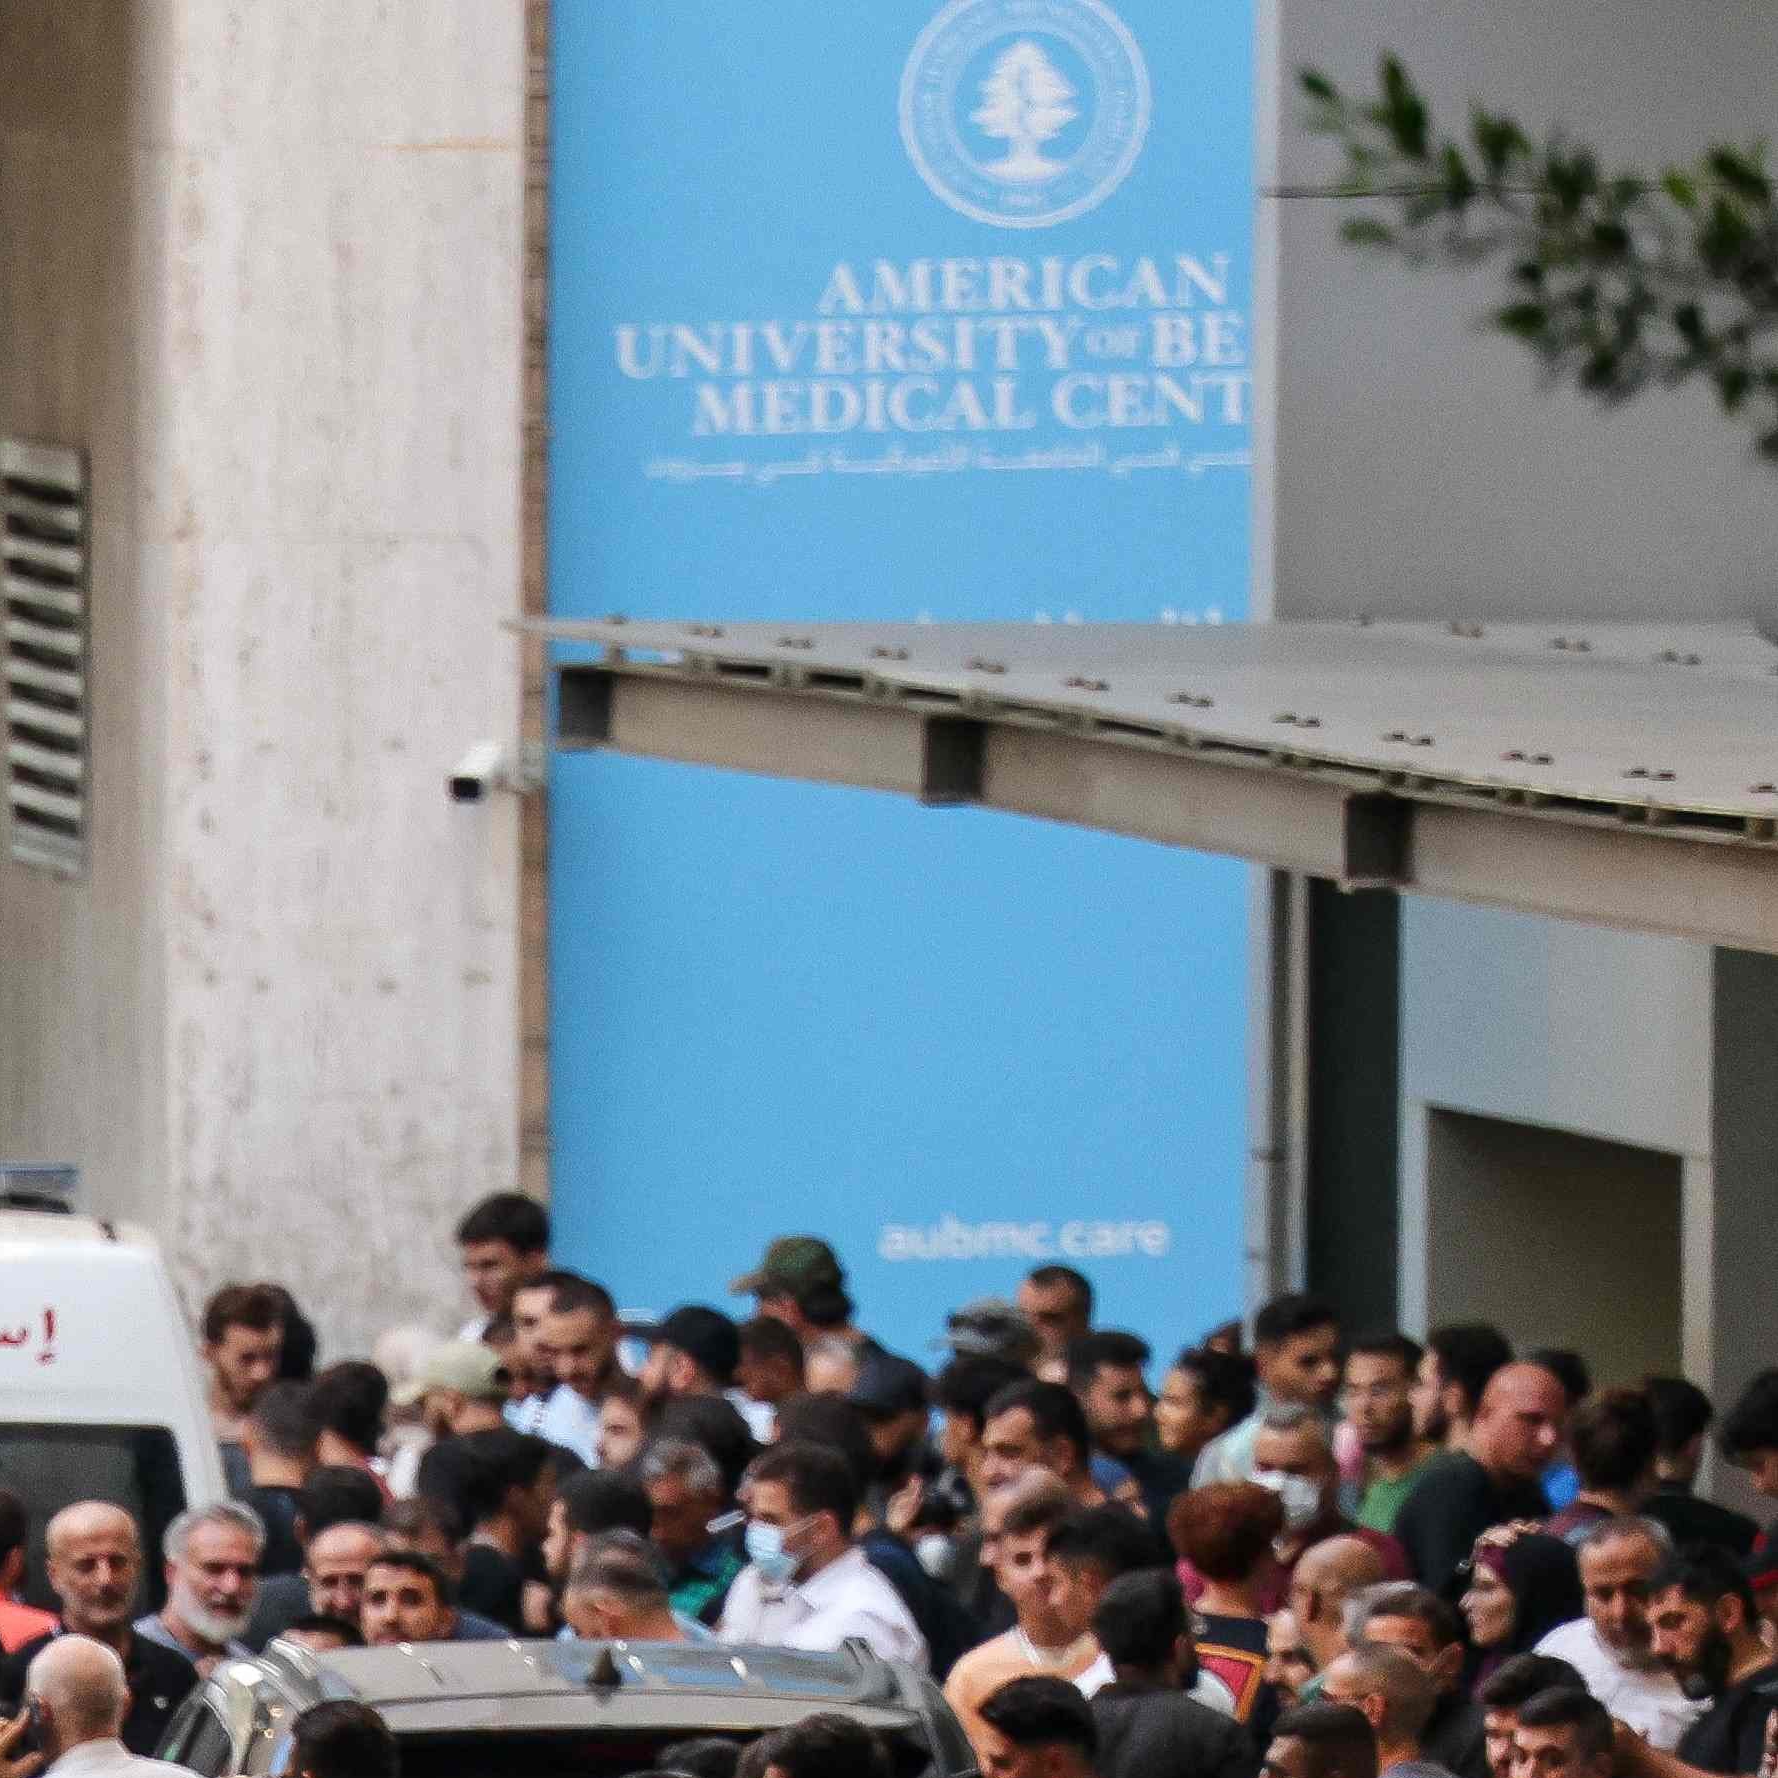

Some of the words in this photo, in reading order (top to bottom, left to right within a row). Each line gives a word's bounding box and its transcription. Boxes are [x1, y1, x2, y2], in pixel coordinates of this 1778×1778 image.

[814, 253, 1232, 315] AMERICAN
[614, 315, 1084, 379] UNIVERSITY
[690, 374, 1038, 437] MEDICAL
